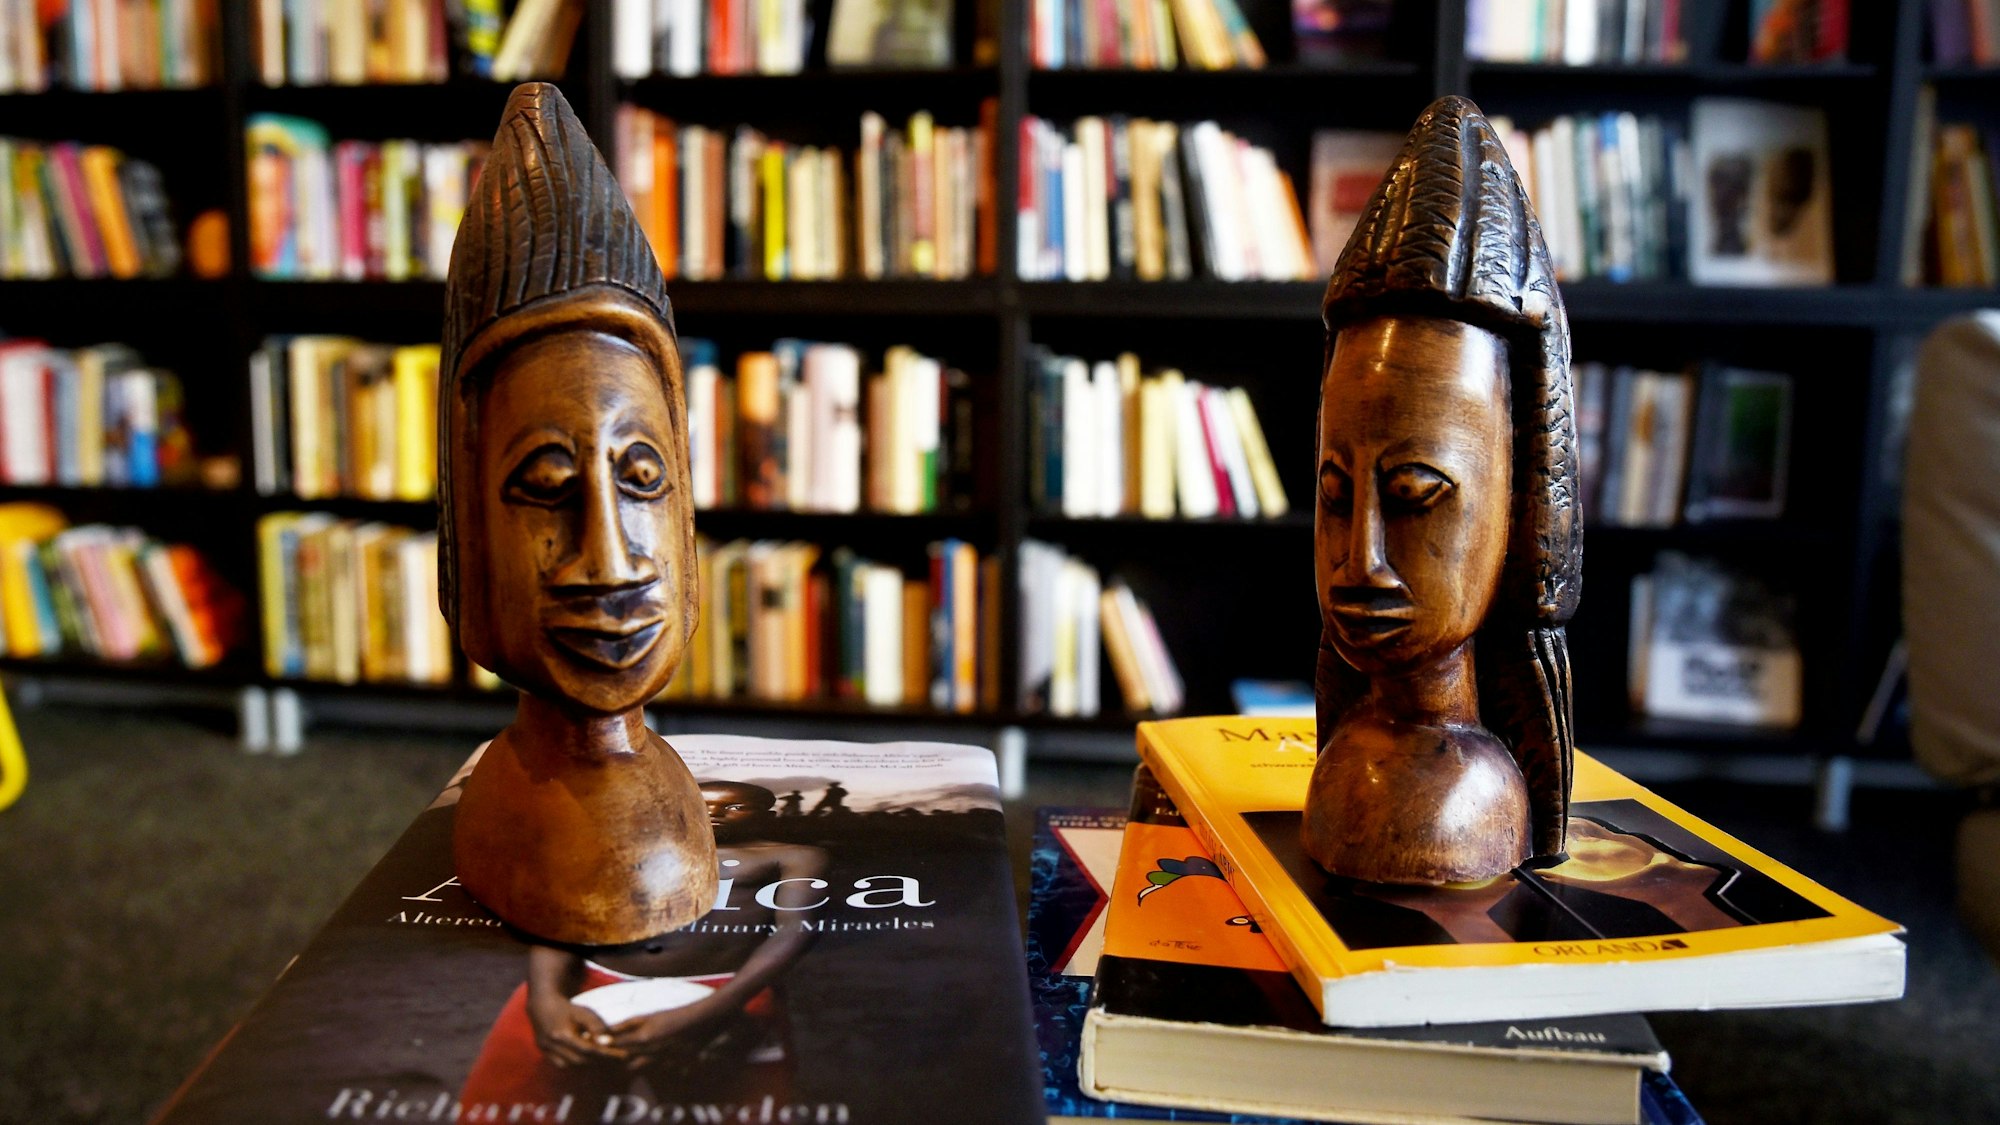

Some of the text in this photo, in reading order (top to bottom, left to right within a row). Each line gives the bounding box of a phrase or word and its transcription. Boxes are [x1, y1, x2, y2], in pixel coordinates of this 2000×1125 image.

[1217, 728, 1316, 741] Ma
[800, 917, 934, 932] Miracles
[1505, 1026, 1607, 1043] Aufbau
[327, 1087, 850, 1124] Richard Dowden
